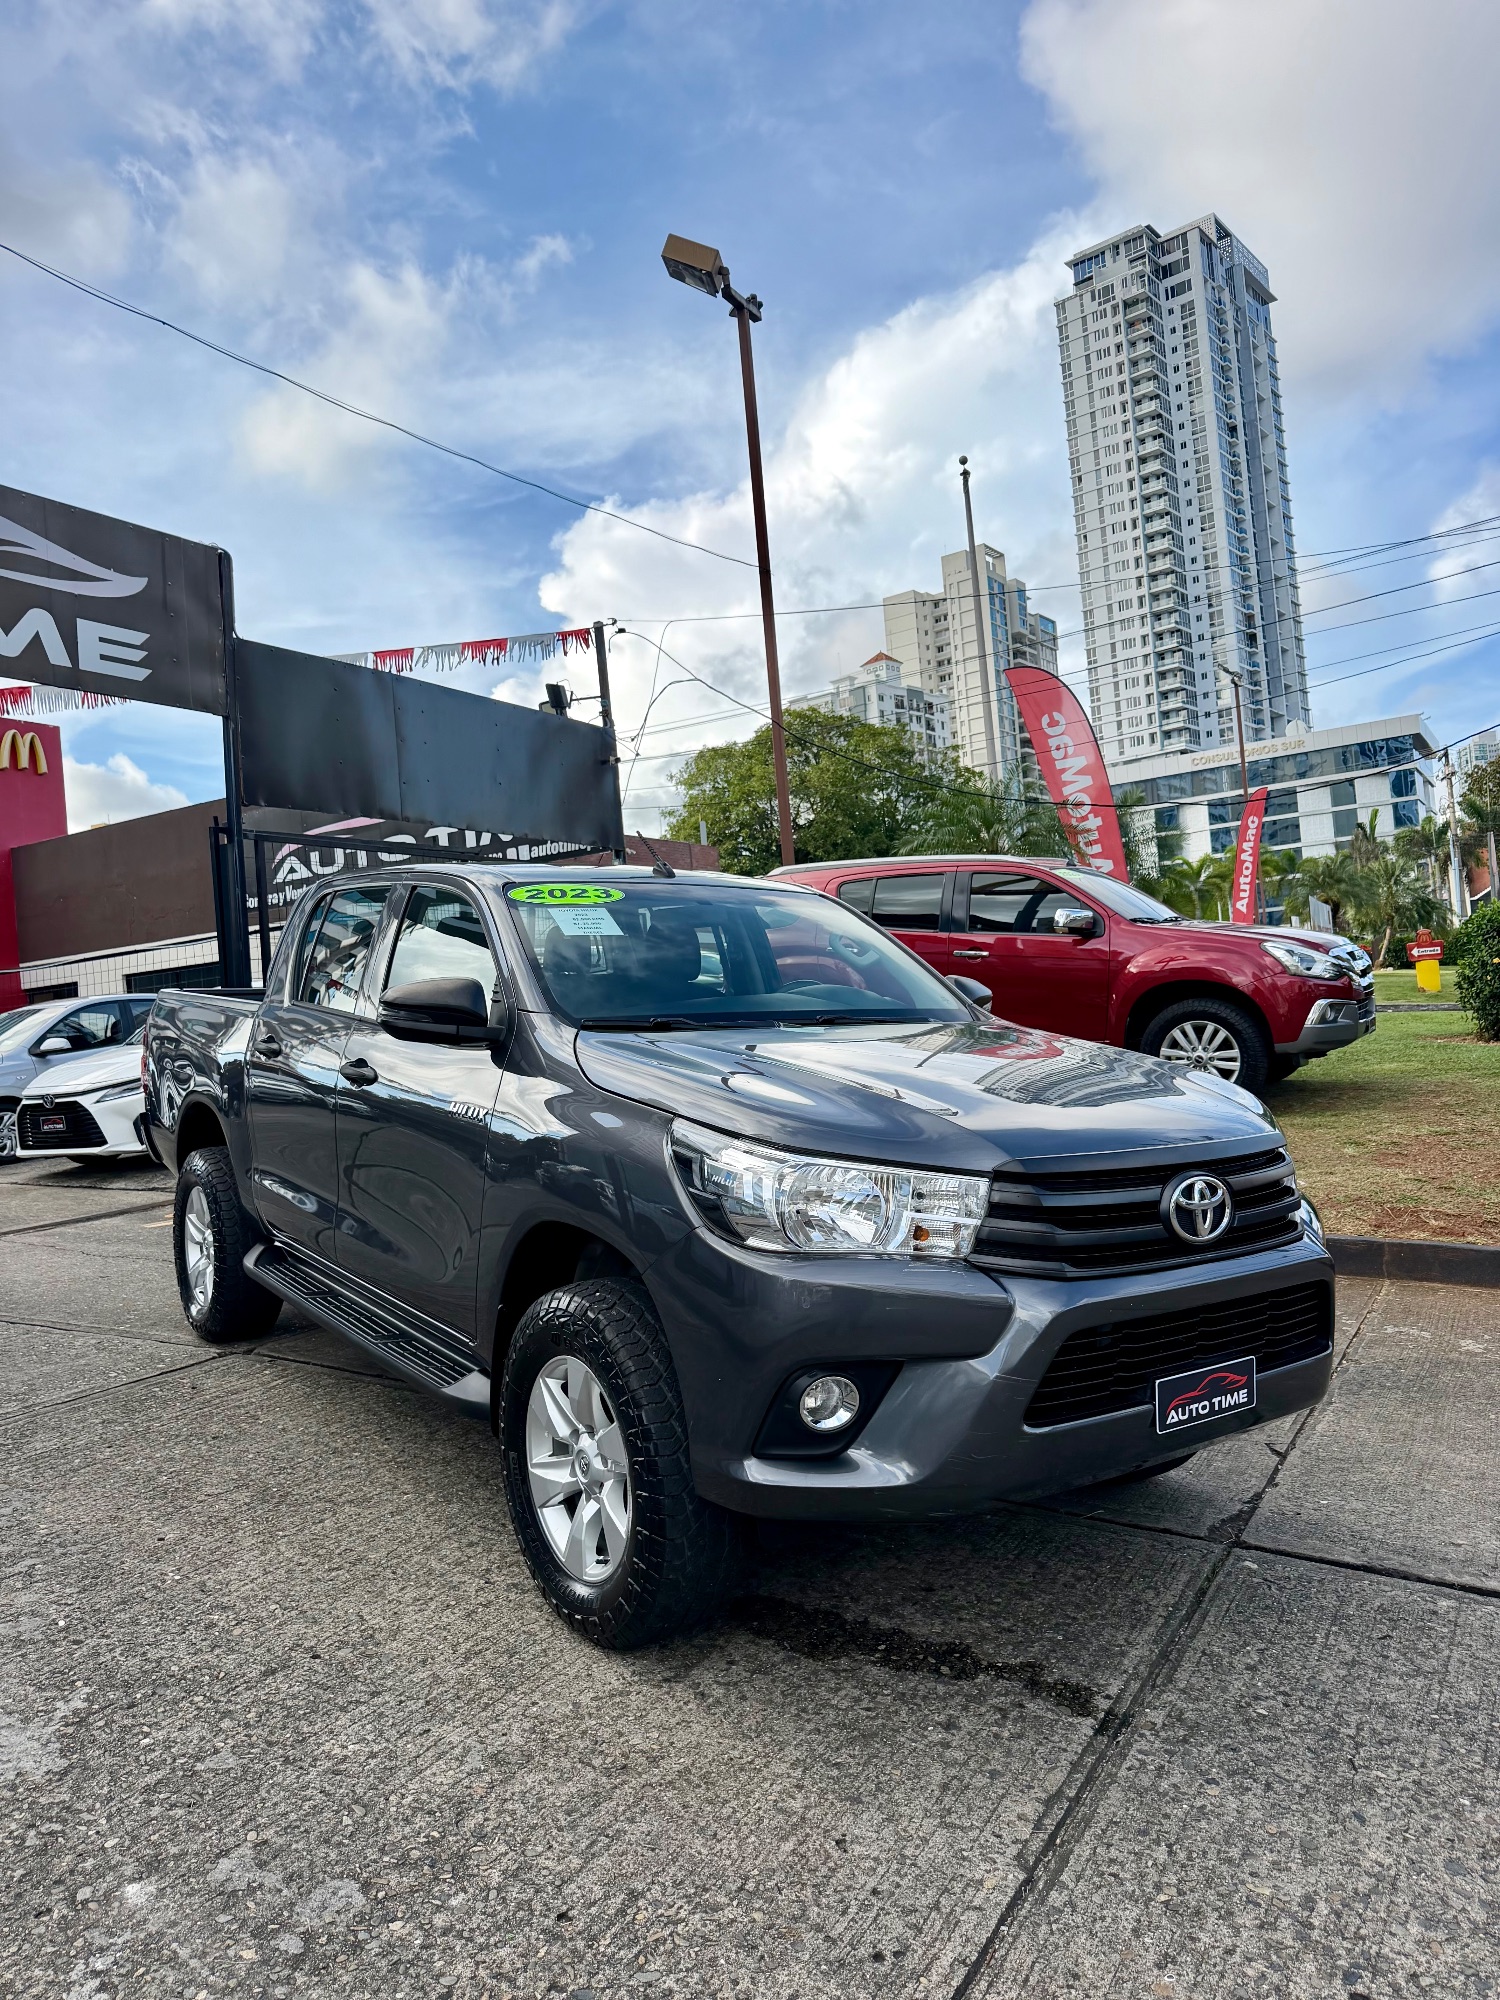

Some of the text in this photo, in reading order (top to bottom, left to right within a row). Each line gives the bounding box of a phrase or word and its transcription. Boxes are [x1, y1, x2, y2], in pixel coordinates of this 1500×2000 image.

[1281, 740, 1306, 751] SUR
[1235, 815, 1259, 914] AutoMac
[524, 888, 615, 900] 2023
[712, 1175, 739, 1187] HILUX
[1166, 1389, 1248, 1425] AUTO TIME
